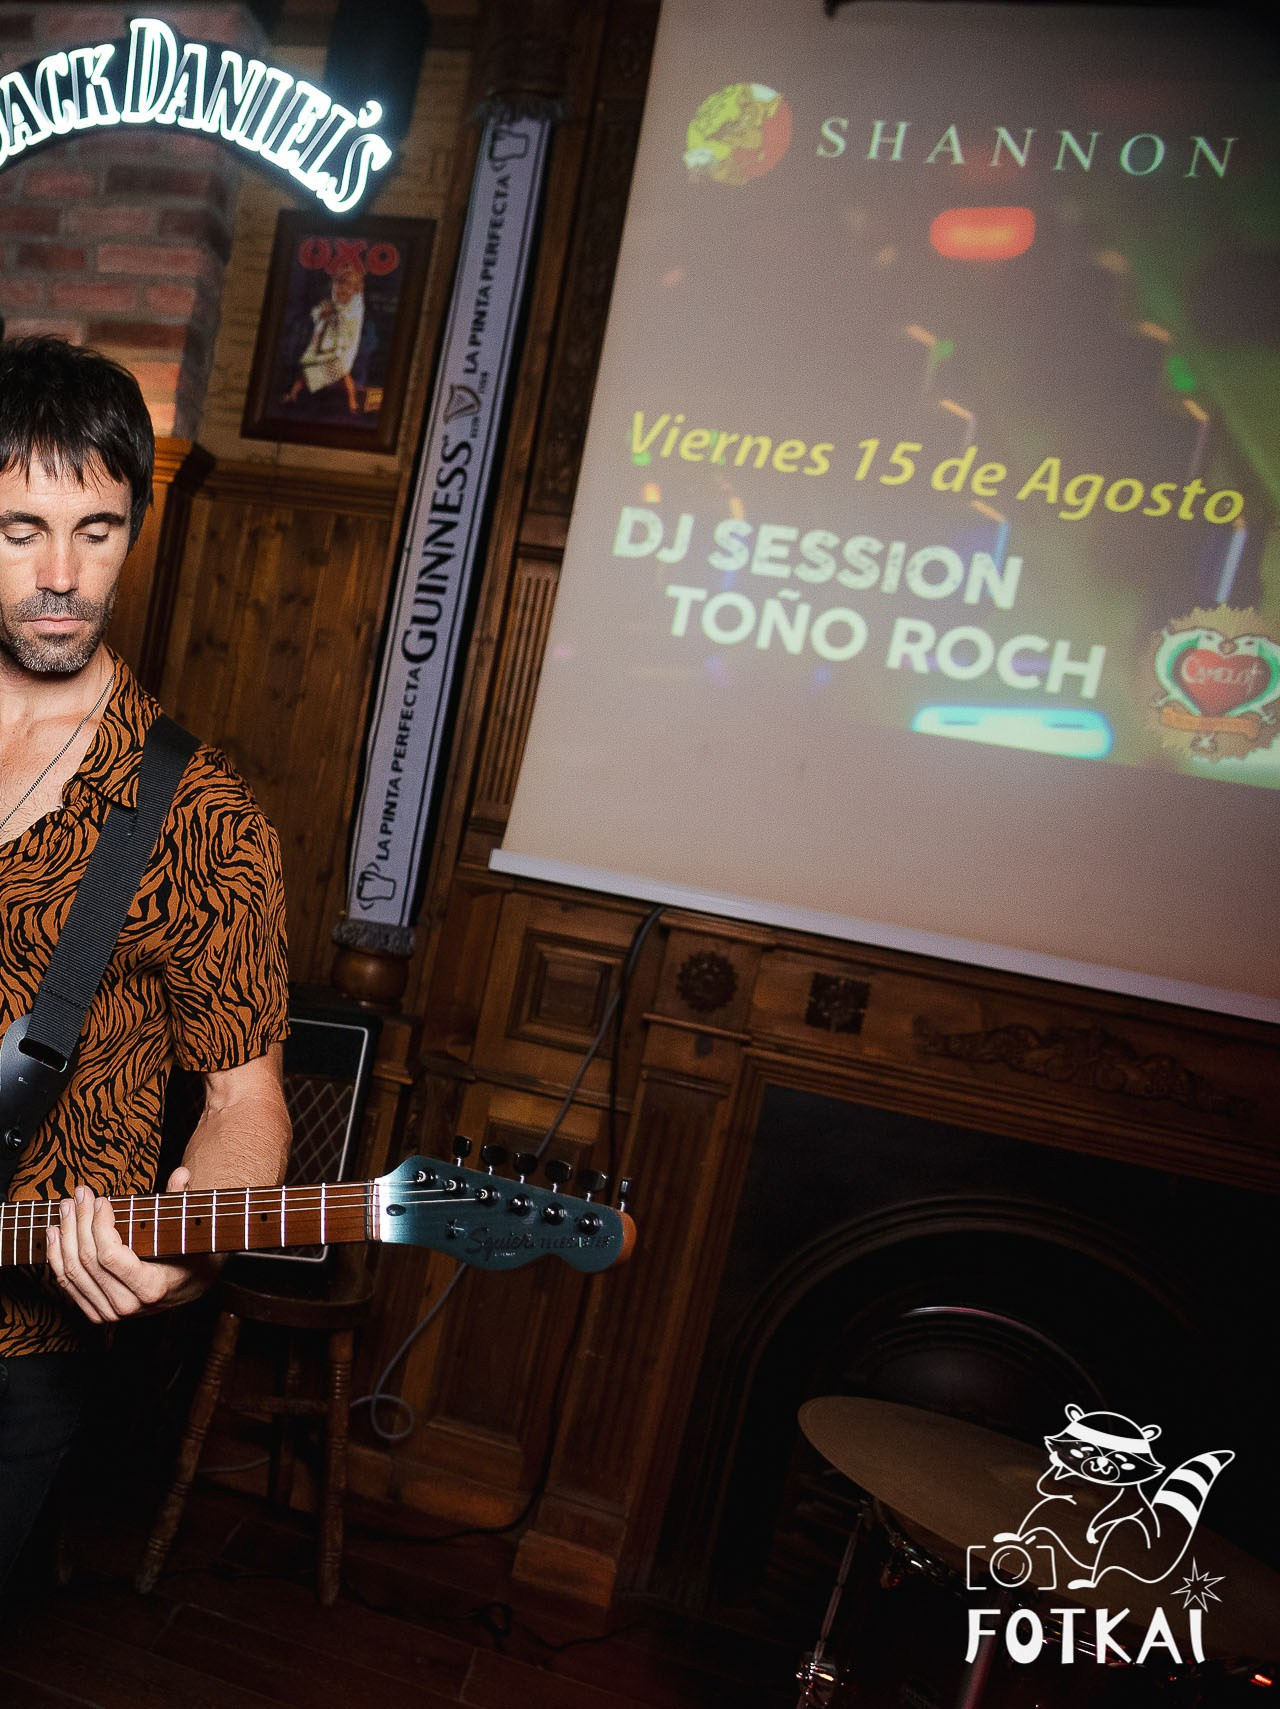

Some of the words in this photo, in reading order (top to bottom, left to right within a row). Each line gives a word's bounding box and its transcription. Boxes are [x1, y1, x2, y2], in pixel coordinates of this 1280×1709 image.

[121, 18, 393, 212] DANIEL'S
[816, 116, 1239, 179] SHANNON
[299, 235, 401, 277] OXO
[480, 174, 511, 281] PERFECTA
[463, 350, 480, 374] LA
[469, 287, 492, 347] PINTA
[630, 410, 834, 477] Viernes
[853, 436, 923, 487] 15
[930, 446, 1008, 498] de
[1015, 456, 1245, 524] Agosto
[401, 437, 473, 665] GUINNESS
[612, 507, 696, 564] DJ
[708, 518, 1022, 610] SESSION
[666, 584, 867, 661] TOÑO
[886, 617, 1106, 699] ROCH
[390, 667, 422, 773] PERFECTA
[376, 838, 392, 861] LA
[380, 775, 404, 838] PINTA
